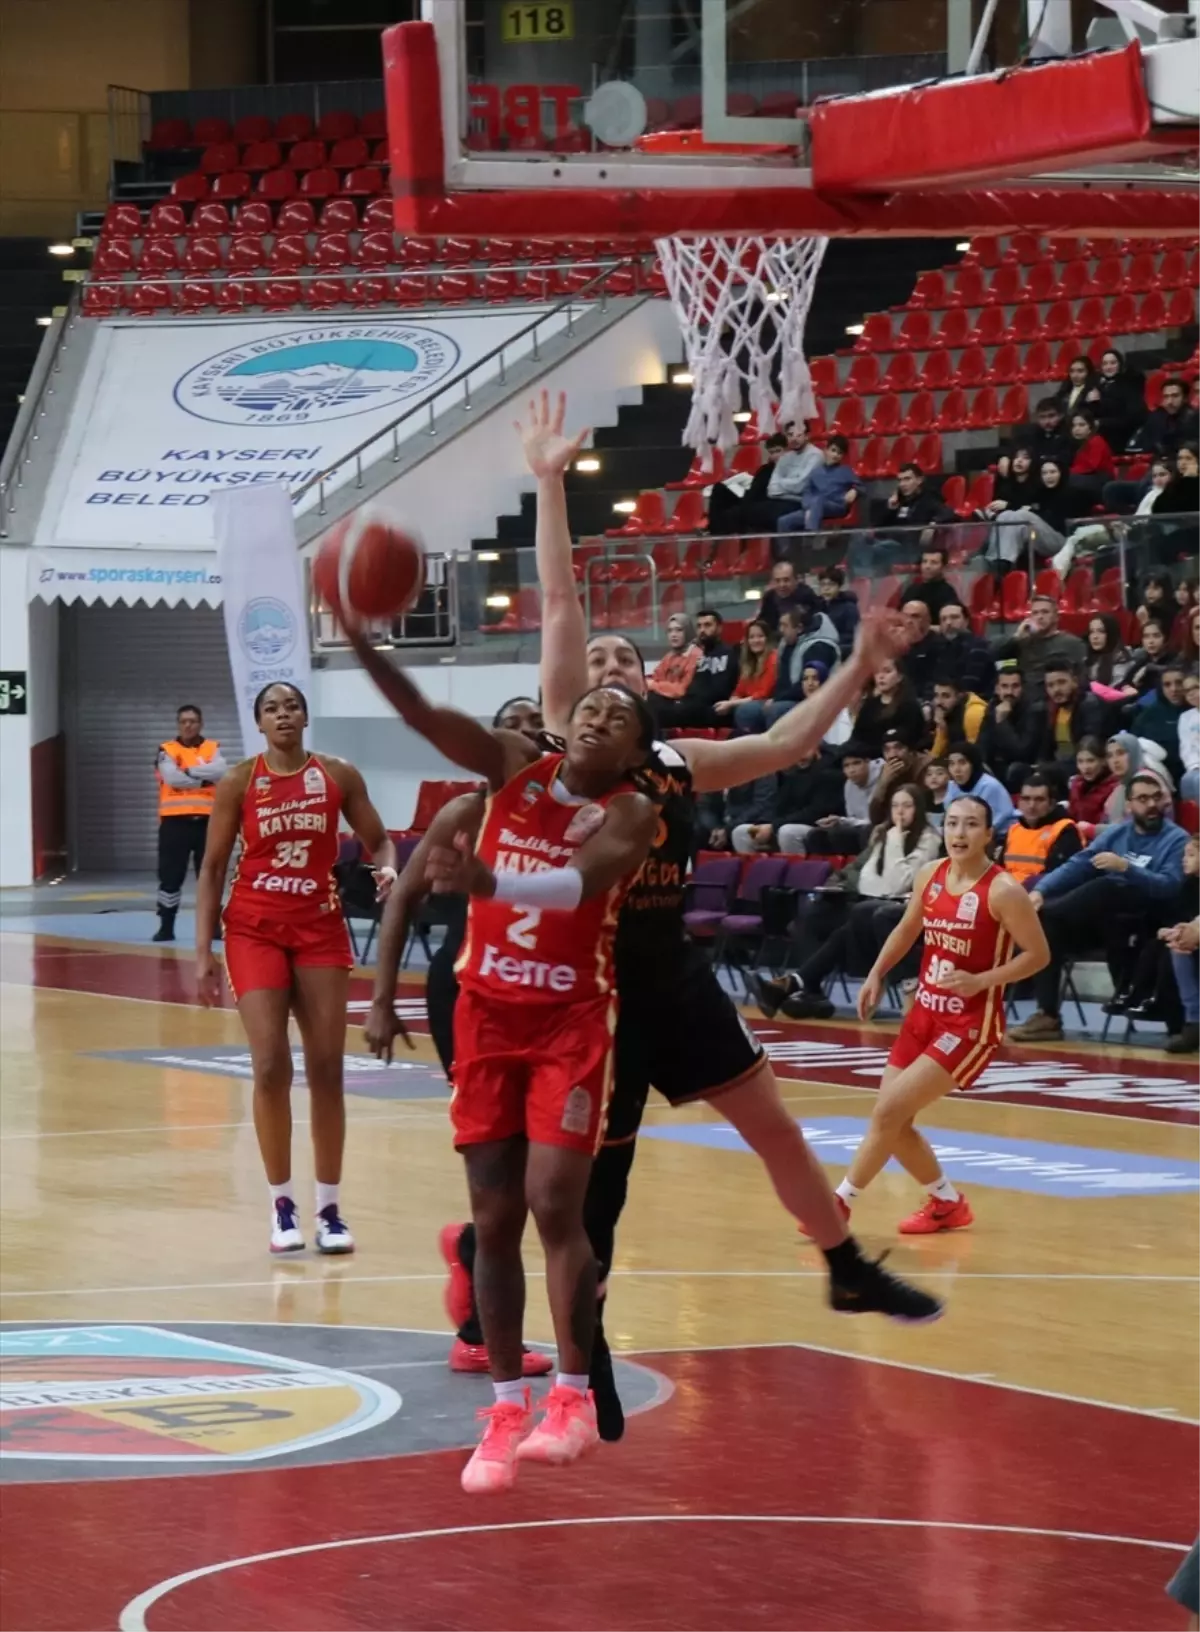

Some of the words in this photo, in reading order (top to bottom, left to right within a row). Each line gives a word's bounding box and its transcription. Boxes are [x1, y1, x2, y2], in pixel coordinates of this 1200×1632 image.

[508, 8, 566, 36] 118
[245, 412, 310, 422] 1869
[161, 446, 323, 461] KAYSERİ
[85, 492, 211, 506] BELED
[57, 567, 222, 585] www.sporaskayseri.co
[258, 812, 328, 839] KAYSERİ
[271, 839, 313, 869] 35
[252, 872, 318, 896] Ferre
[505, 903, 543, 950] 2
[479, 943, 577, 992] Ferre
